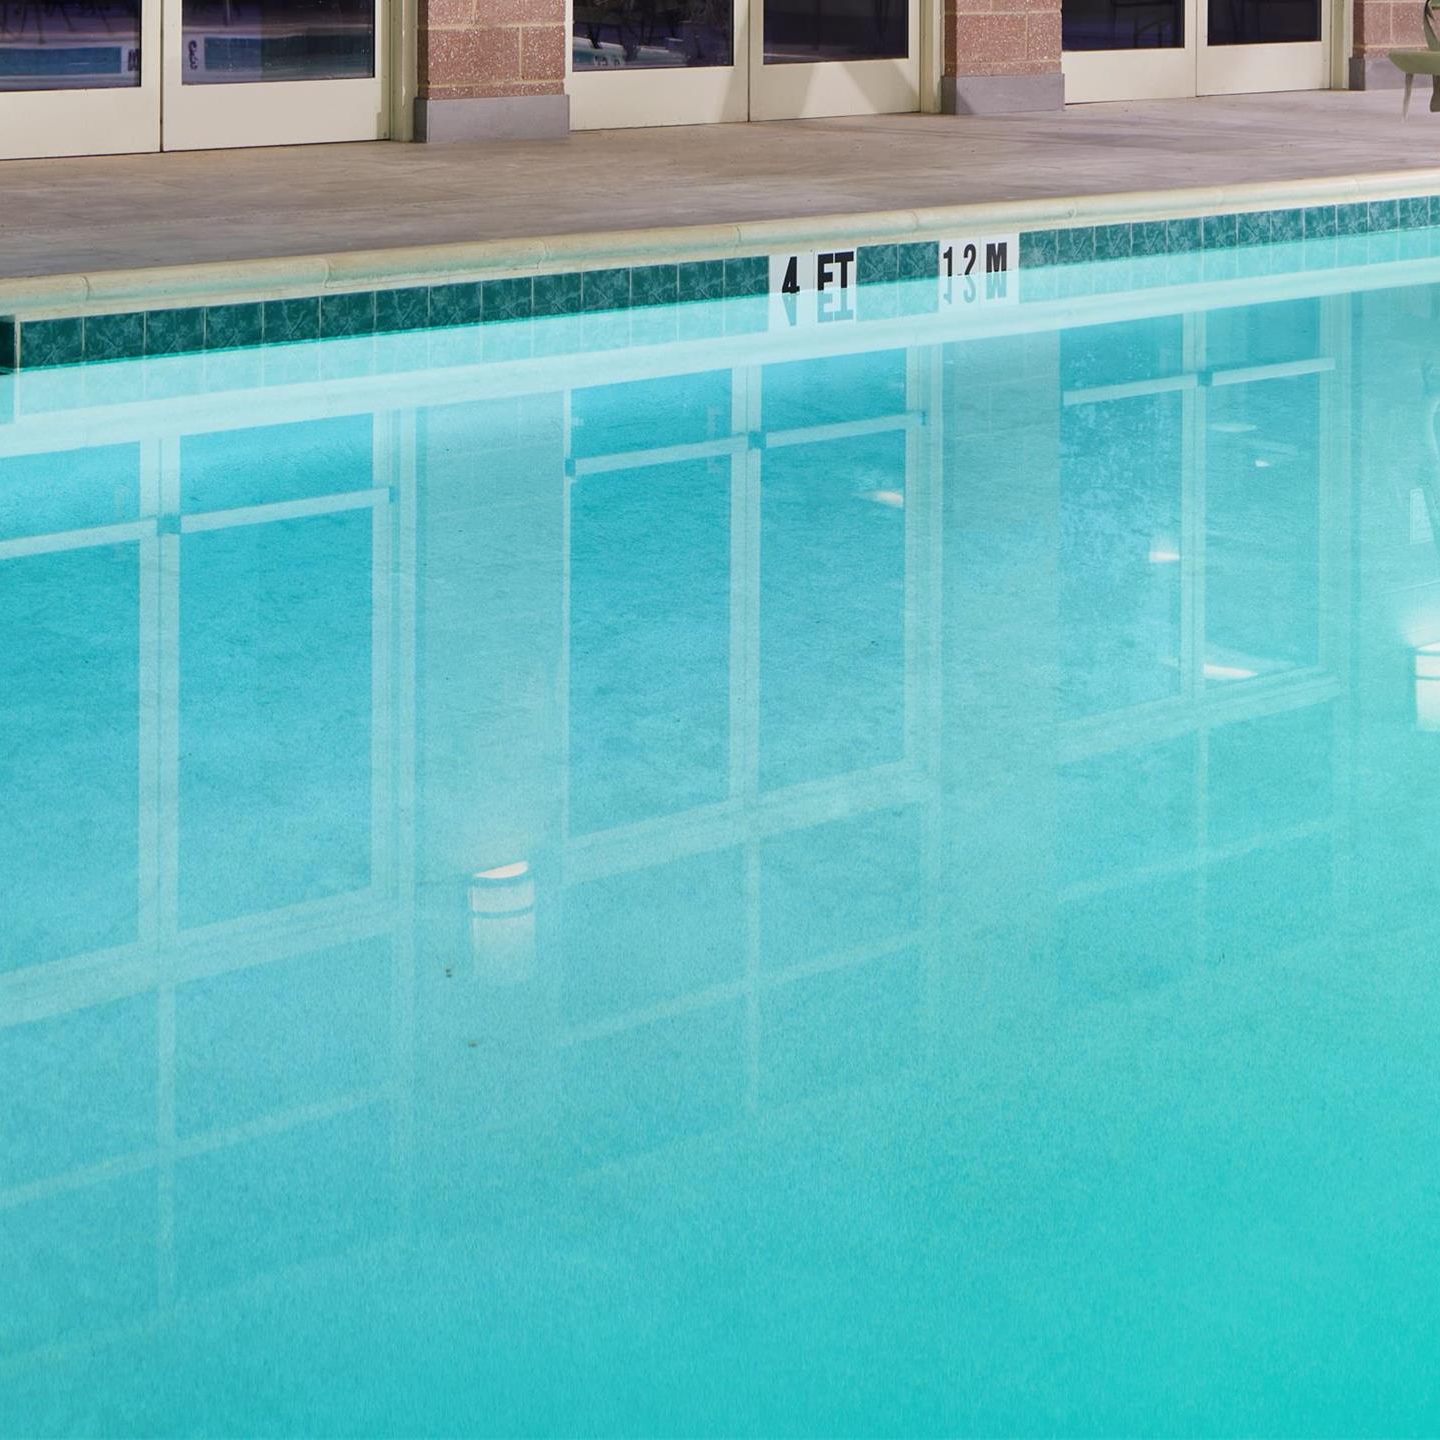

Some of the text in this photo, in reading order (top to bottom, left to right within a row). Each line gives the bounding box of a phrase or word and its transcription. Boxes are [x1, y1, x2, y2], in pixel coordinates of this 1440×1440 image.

[782, 251, 854, 294] 4 FT
[943, 243, 976, 277] 12
